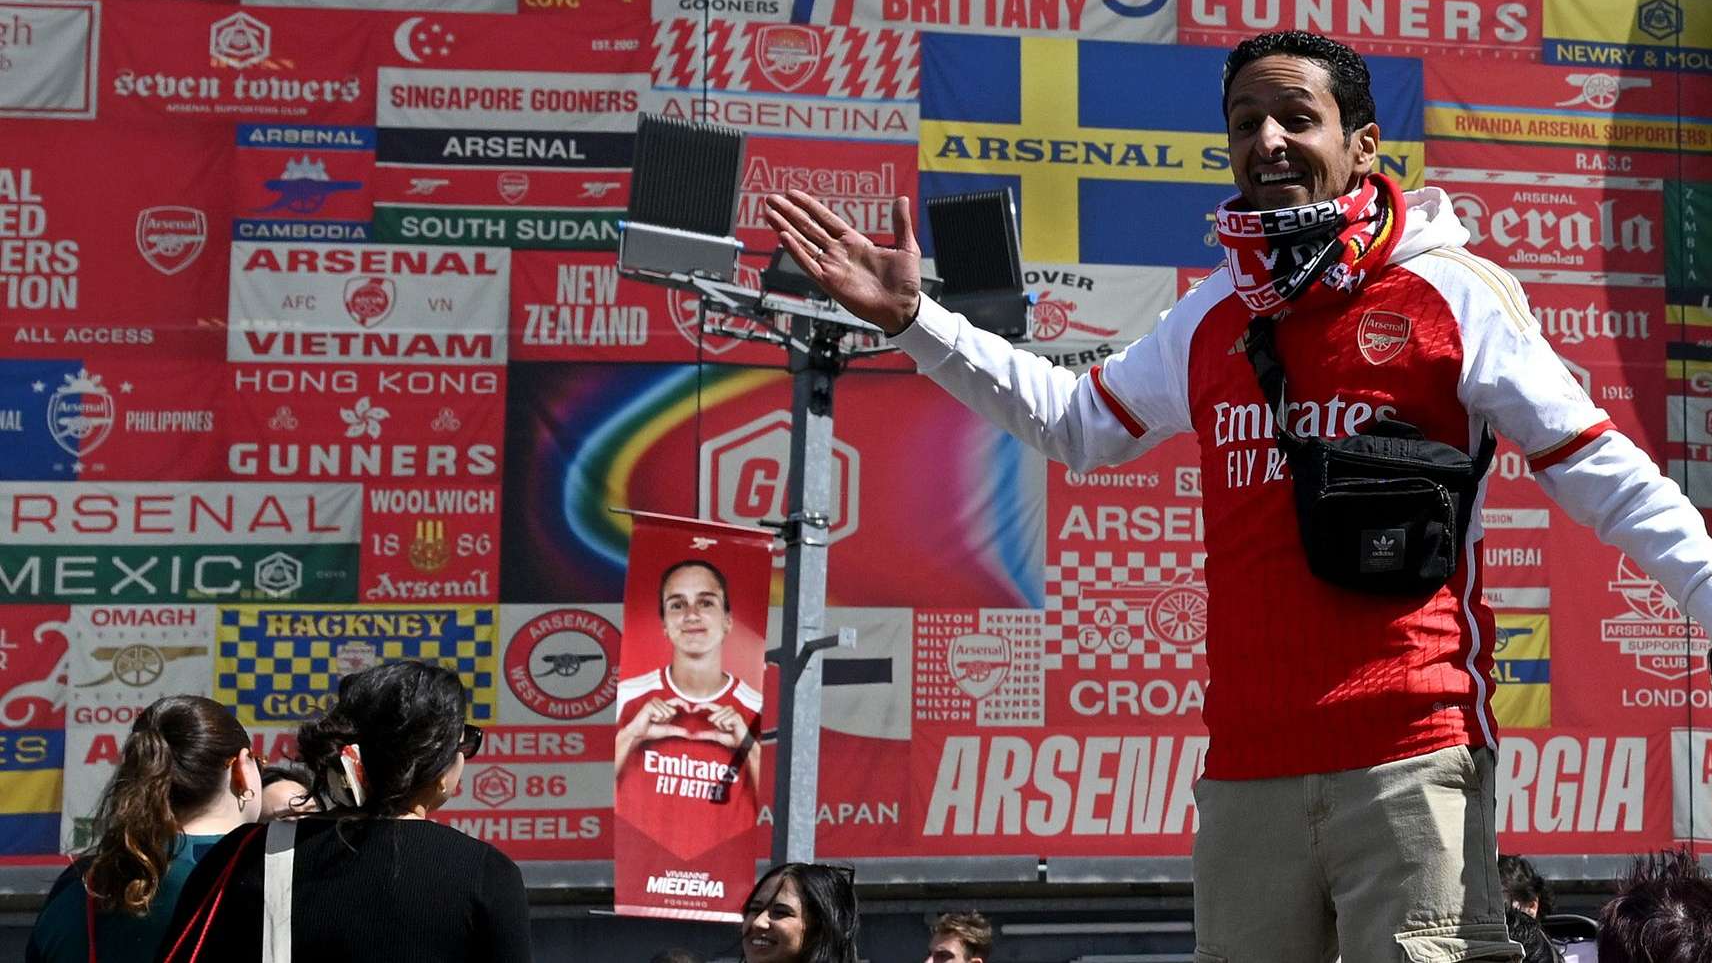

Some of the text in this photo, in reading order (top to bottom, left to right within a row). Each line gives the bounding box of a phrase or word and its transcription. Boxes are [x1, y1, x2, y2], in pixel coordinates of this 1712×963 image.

[390, 85, 639, 113] SINGAPORE GOONERS
[249, 127, 365, 146] ARSENAL
[442, 135, 586, 160] ARSENAL
[936, 135, 1184, 169] ARSENAL
[1575, 153, 1633, 171] R.A.S.C
[1513, 192, 1577, 206] ARSENAL
[239, 222, 366, 240] CAMBODIA
[242, 249, 497, 276] ARSENAL
[280, 294, 453, 312] AFC VN
[14, 327, 153, 345] ALL ACCESS
[1368, 319, 1404, 332] Arsenal
[245, 331, 493, 359] VIETNAM
[235, 370, 499, 394] HONG KONG
[125, 410, 214, 432] PHILIPPINES
[227, 443, 497, 476] GUNNERS
[1228, 449, 1254, 489] FLY
[370, 490, 495, 515] WOOLWICH
[91, 607, 196, 627] OMAGH
[266, 613, 448, 638] HACKNEY
[917, 613, 1042, 624] MILTON KEYNES
[1605, 623, 1683, 637] ARSENAL
[1650, 656, 1688, 670] CLUB
[916, 698, 1041, 708] MILTON KEYNES
[916, 710, 1040, 720] MILTON KEYNES
[644, 750, 738, 784] Emirates
[656, 775, 726, 801] FLY BETTER
[646, 876, 725, 899] MIEDEMA
